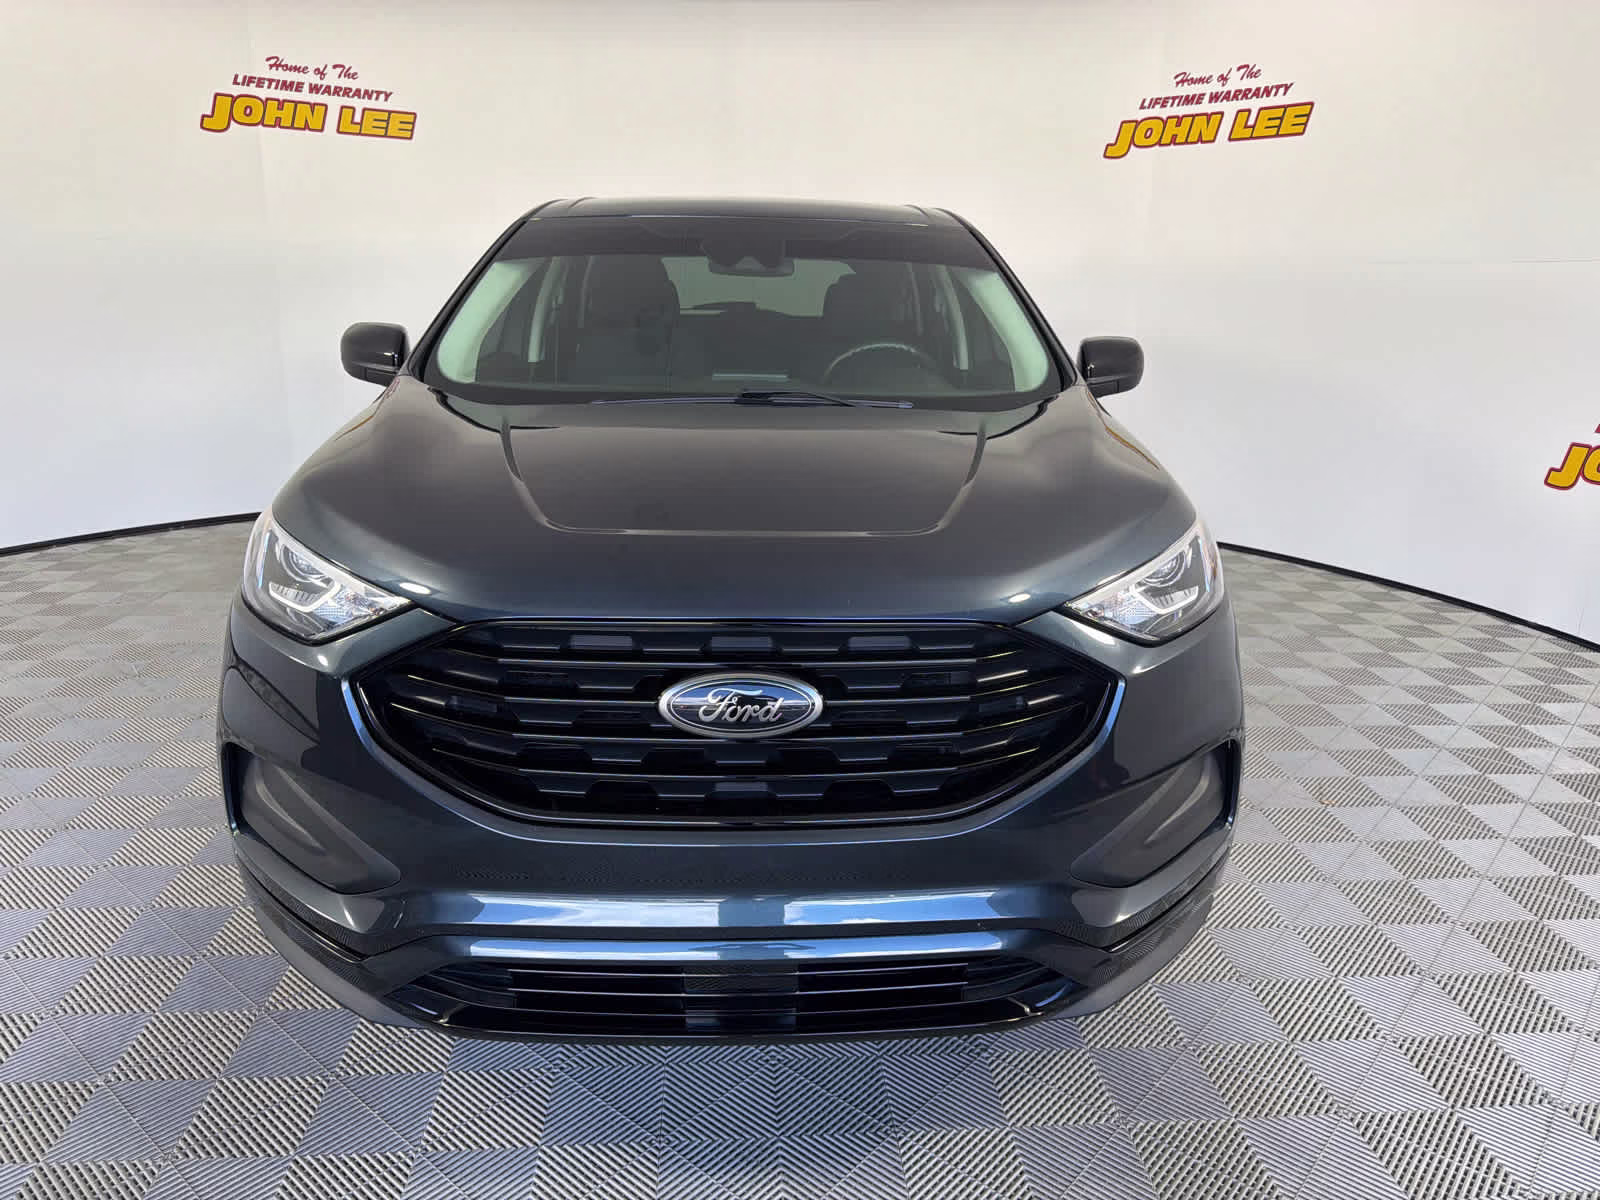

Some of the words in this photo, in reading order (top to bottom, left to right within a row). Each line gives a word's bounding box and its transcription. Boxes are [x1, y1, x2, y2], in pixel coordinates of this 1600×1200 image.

[265, 56, 310, 75] Home
[313, 65, 327, 81] of
[332, 63, 359, 80] The
[1173, 71, 1214, 88] Home
[1217, 68, 1233, 87] of
[1236, 63, 1262, 81] The
[232, 73, 305, 94] LIFETIME
[308, 82, 393, 103] WARRANTY
[1139, 92, 1205, 110] LIFETIME
[1208, 82, 1294, 105] WARRANTY
[200, 92, 328, 133] JOHN
[336, 105, 417, 140] LEE
[1103, 111, 1224, 159] JOHN
[1228, 101, 1315, 142] LEE
[698, 687, 785, 722] Ford
